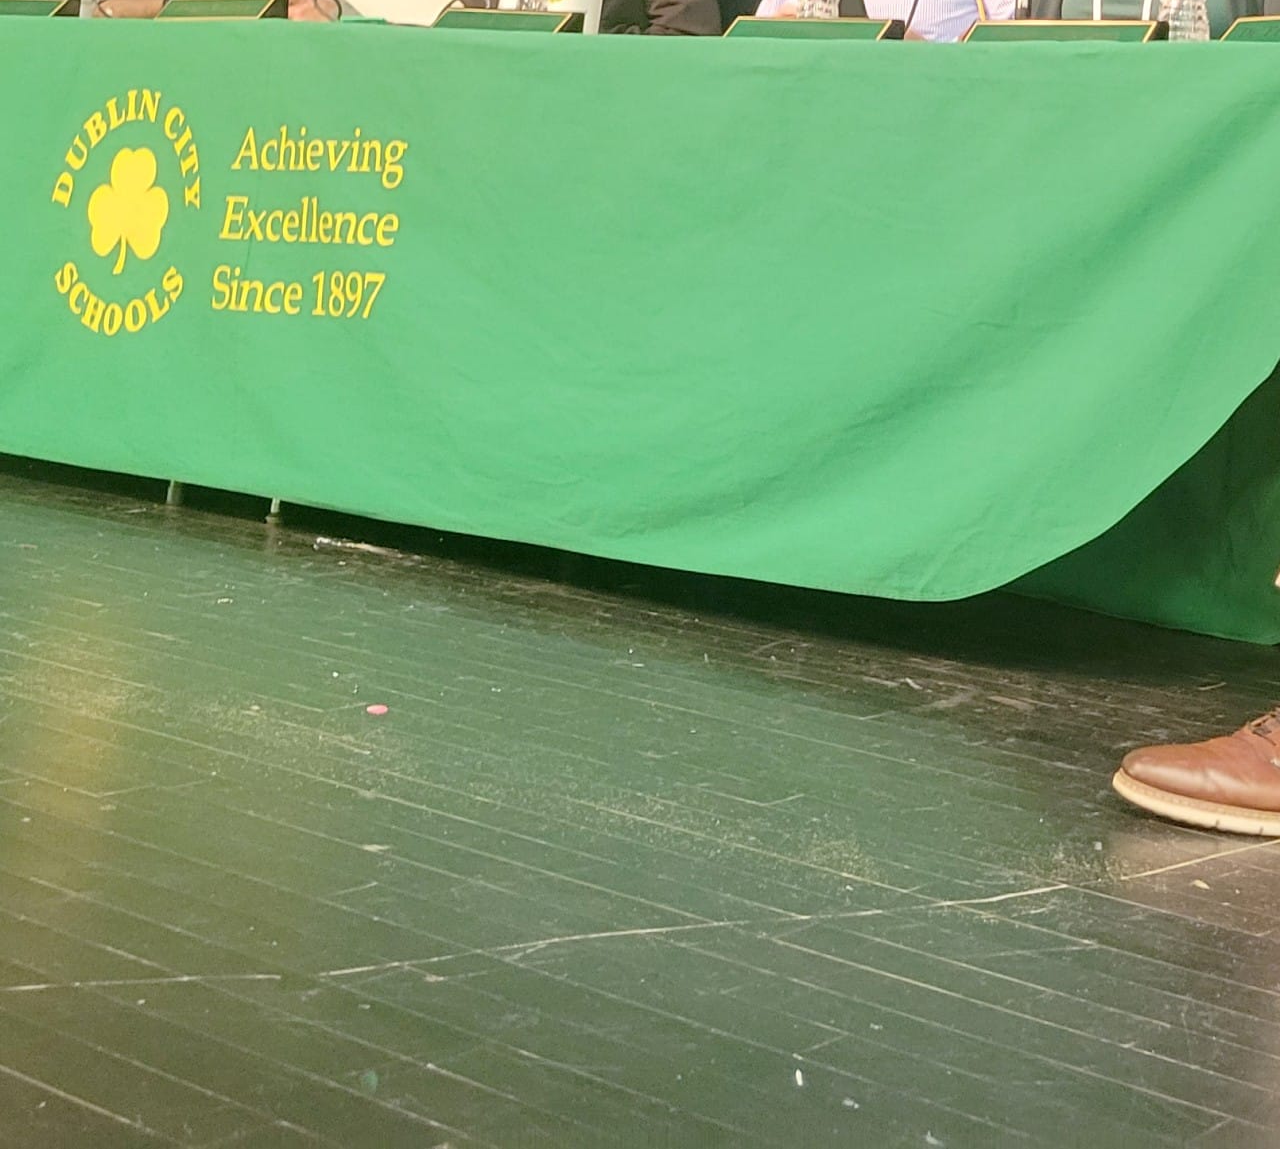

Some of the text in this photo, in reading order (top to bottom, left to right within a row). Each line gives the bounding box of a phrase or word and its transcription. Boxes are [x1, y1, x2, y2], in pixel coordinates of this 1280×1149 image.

[52, 89, 200, 208] DUBLIN CITY
[231, 125, 407, 189] Achieving
[219, 195, 398, 246] Excellence
[54, 262, 184, 336] SCHOOLS
[211, 265, 386, 318] Since 1897
